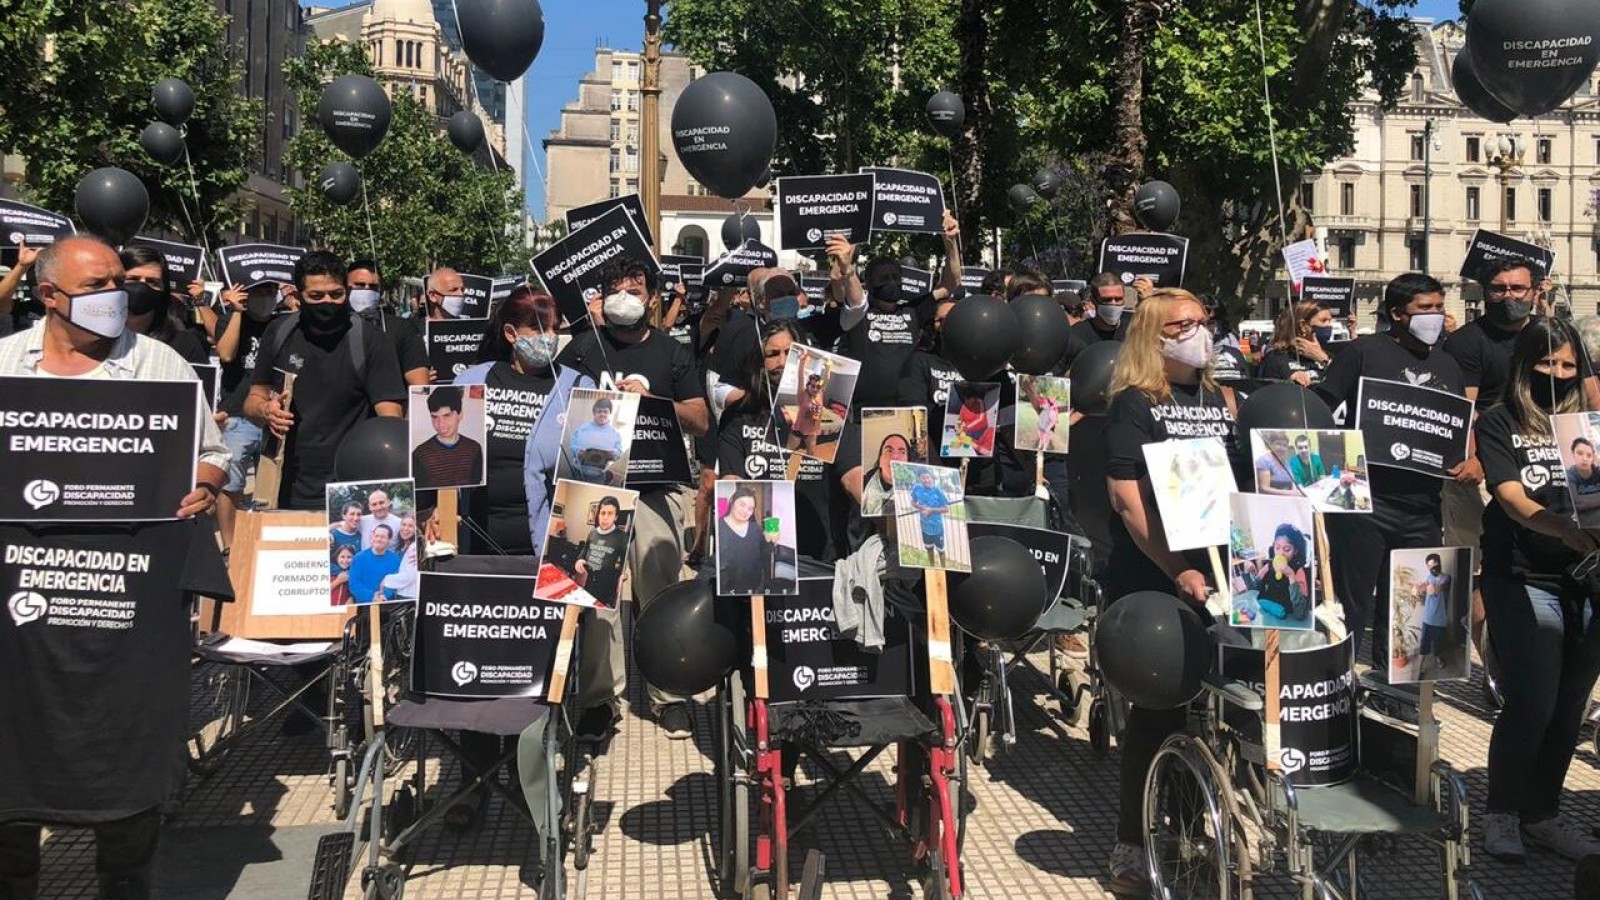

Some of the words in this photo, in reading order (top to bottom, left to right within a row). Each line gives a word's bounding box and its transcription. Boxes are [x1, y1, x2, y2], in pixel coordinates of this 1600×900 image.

[1503, 36, 1592, 50] DISCAPACIDAD
[1541, 49, 1558, 58] EN
[1508, 56, 1583, 68] EMERGENCIA
[875, 182, 926, 194] SCAPACIDAD
[926, 187, 937, 195] EN
[785, 193, 854, 204] DISCAPACIDAD
[855, 191, 867, 201] EN
[878, 193, 931, 204] EMERGENCIA
[0, 207, 54, 221] ISCAPACIDAD
[799, 204, 859, 216] EMERGENCIA
[546, 234, 612, 280] DISCAPACIDAD
[611, 225, 628, 239] EN
[762, 251, 772, 259] EN
[1108, 244, 1166, 255] DISCAPACIDAD
[1166, 247, 1178, 255] EN
[183, 257, 195, 265] EN
[562, 243, 625, 285] EMERGENCIA
[1117, 254, 1169, 264] EMERGENCIA
[434, 333, 484, 343] DISCAPACI
[445, 343, 479, 353] EMERG
[487, 387, 549, 406] SCAPACIDA
[486, 401, 541, 420] EMERGENC
[1368, 399, 1451, 424] DISCAPACIDAD
[1450, 415, 1464, 429] EN
[0, 411, 144, 431] ISCAPACIDAD
[149, 414, 178, 430] EN
[1383, 414, 1454, 440] EMERGENCIA
[495, 424, 531, 434] DISCAPA
[9, 434, 155, 453] EMERGENCIA
[64, 491, 135, 500] DISCAPACIDAD
[5, 544, 126, 570] DISCAPACIDAD
[126, 554, 150, 573] EN
[1044, 551, 1059, 563] EN
[19, 568, 126, 593] EMERGENCIA
[272, 574, 318, 583] FORMADO
[77, 599, 136, 609] PERMANENTE
[48, 605, 135, 619] DISCAPACIDAD
[425, 602, 540, 619] DISCAPACIDAD
[543, 607, 564, 620] EN
[766, 606, 832, 623] DISCAPAC
[443, 624, 547, 639] EMERGENCIA
[781, 626, 836, 643] EMERG
[480, 671, 533, 679] DISCAPACIDAD
[1279, 695, 1350, 721] MERGENCI
